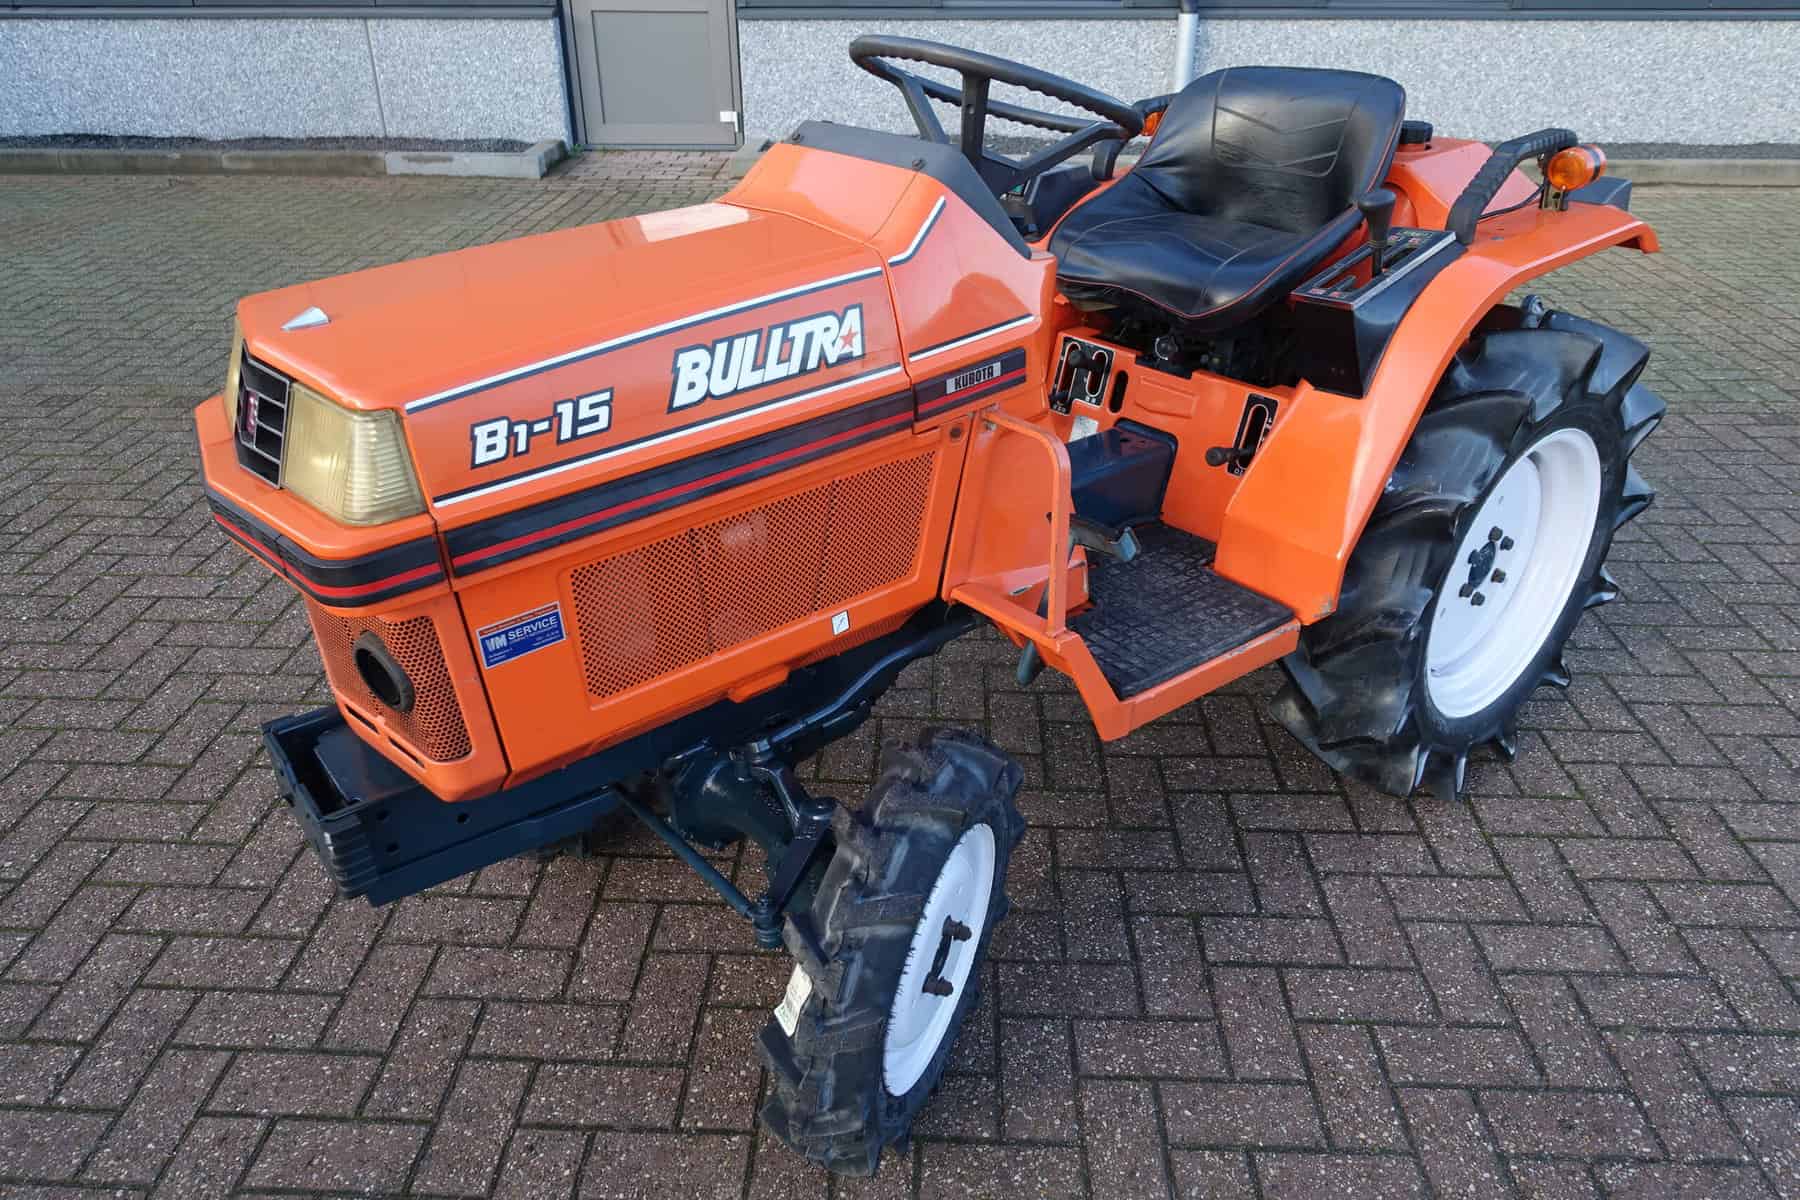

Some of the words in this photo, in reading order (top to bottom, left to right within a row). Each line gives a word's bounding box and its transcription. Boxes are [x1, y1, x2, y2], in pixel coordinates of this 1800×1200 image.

[669, 305, 863, 411] BULLTRA
[954, 365, 994, 390] KUBOTA
[472, 388, 613, 467] B1-15
[507, 615, 558, 641] SERVICE
